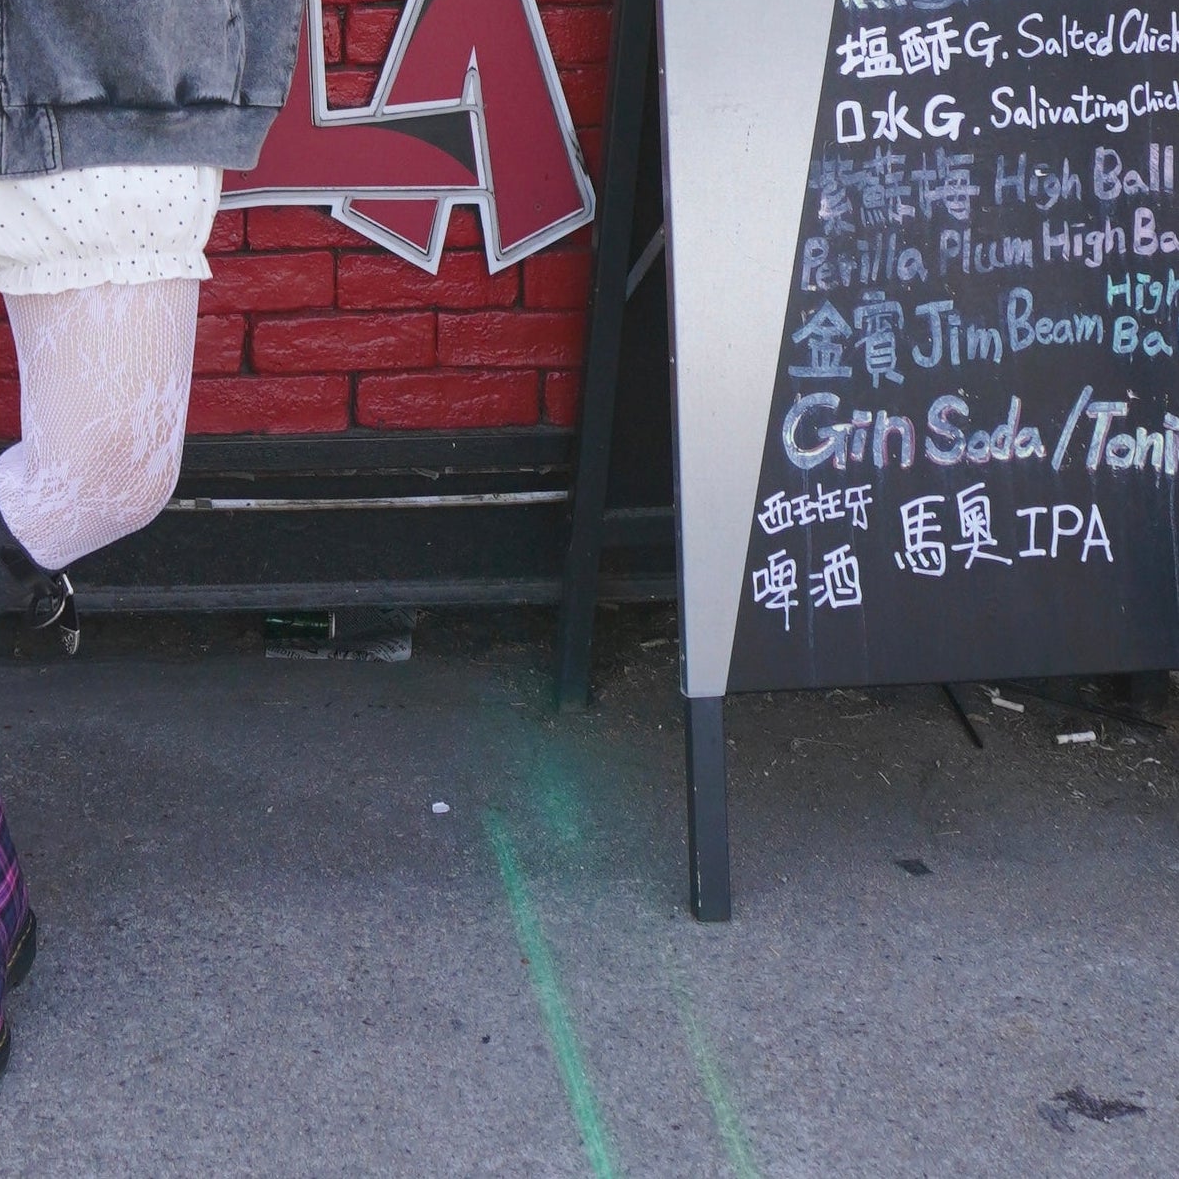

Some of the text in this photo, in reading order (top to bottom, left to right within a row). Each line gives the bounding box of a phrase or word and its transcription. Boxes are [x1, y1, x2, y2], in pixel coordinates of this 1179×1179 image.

[1018, 12, 1116, 58] Salted
[990, 85, 1129, 133] Salivating
[995, 151, 1082, 211] High
[1093, 143, 1175, 201] Ball
[939, 228, 1035, 275] Plum
[1042, 218, 1127, 268] High
[912, 300, 1003, 368] Jim
[1006, 287, 1104, 352] Beam
[782, 392, 916, 471] Gin
[757, 482, 873, 535] 西班牙
[1016, 503, 1115, 563] IPA
[752, 544, 863, 631] 啤酒
